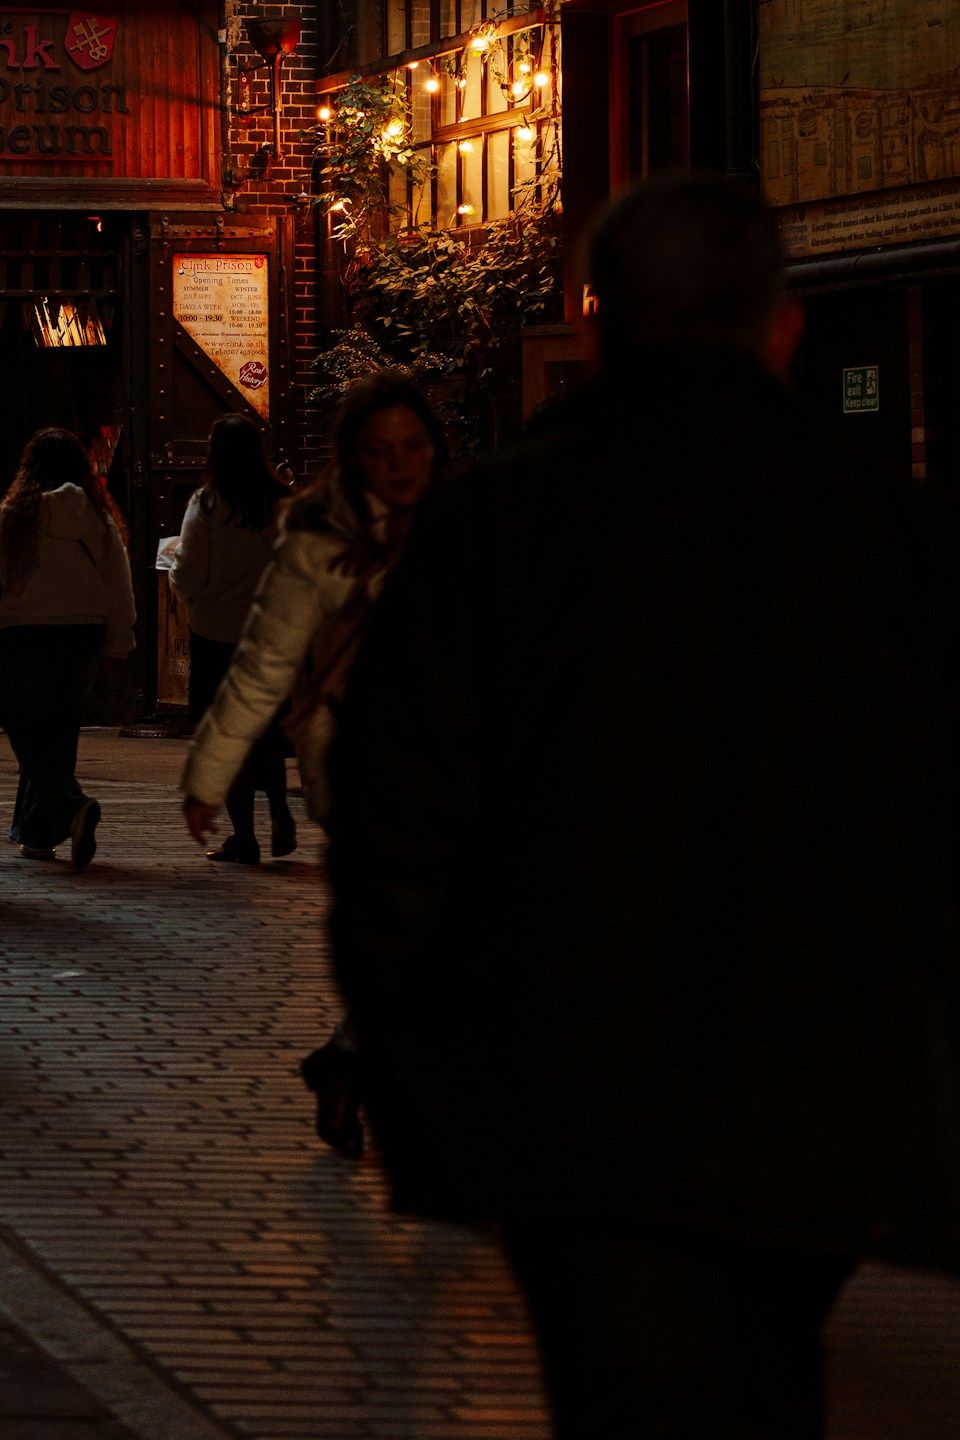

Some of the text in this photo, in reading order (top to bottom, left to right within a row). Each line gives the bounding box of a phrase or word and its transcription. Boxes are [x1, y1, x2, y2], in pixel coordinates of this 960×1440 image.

[181, 260, 253, 271] Clink Prison
[193, 277, 223, 286] Opening
[847, 372, 863, 384] Fire
[847, 383, 861, 397] exit
[845, 396, 877, 409] Keep clear
